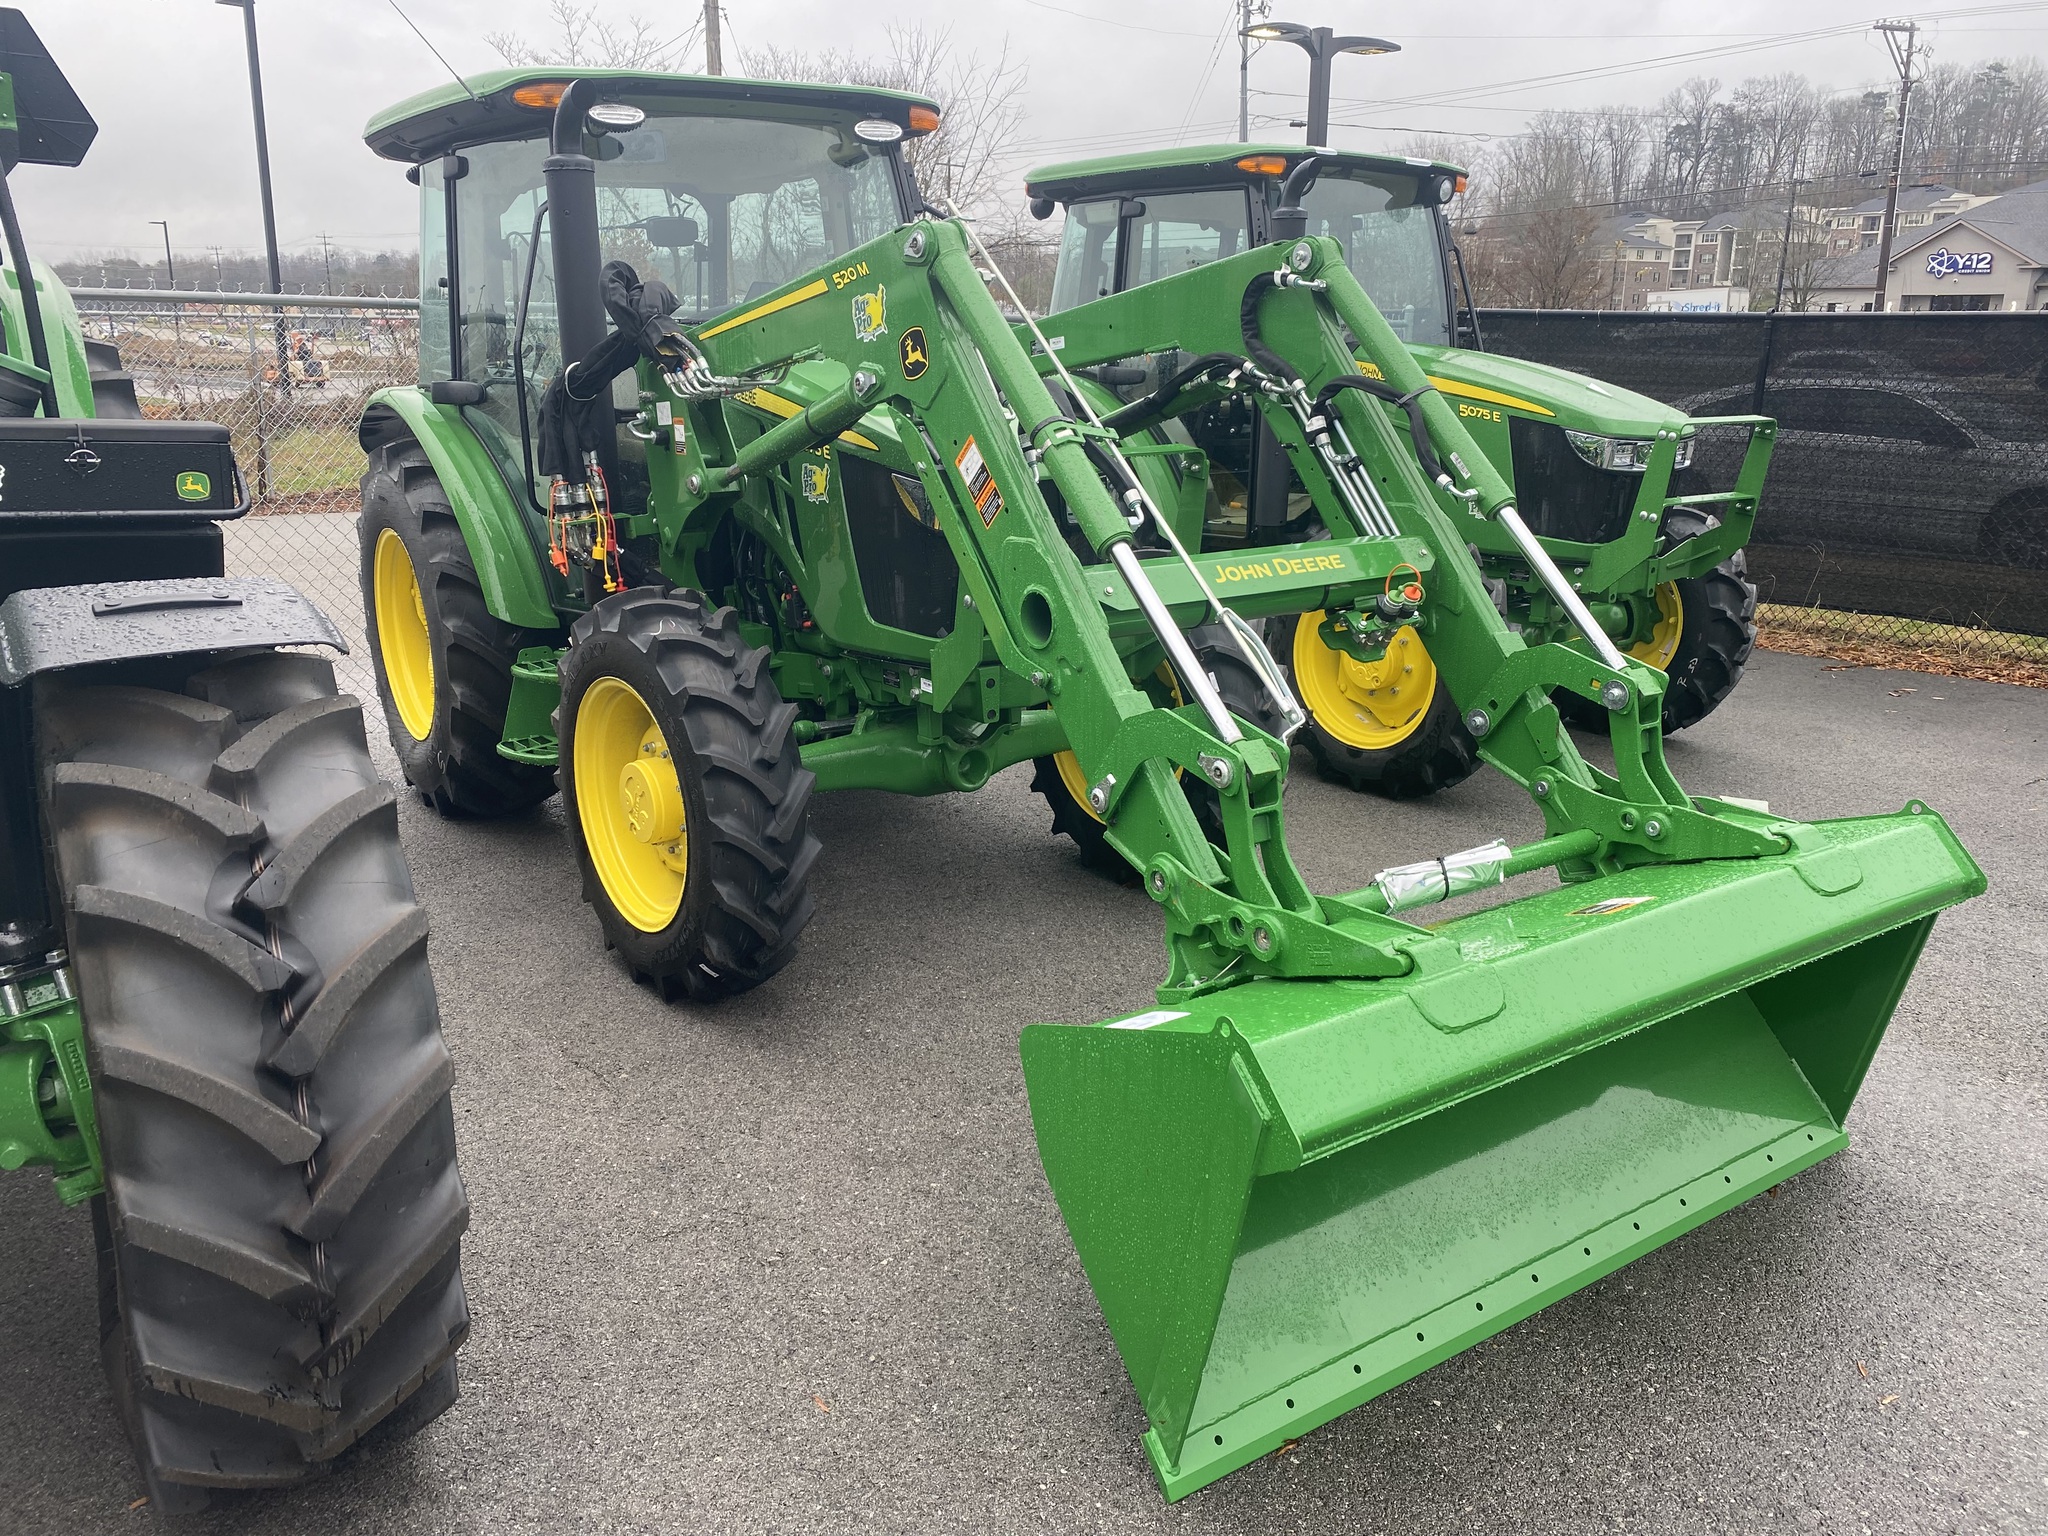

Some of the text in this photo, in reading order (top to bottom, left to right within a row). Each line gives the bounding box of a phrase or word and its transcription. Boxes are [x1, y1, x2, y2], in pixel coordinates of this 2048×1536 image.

[1955, 253, 1992, 269] Y-12
[832, 261, 870, 290] 520 M
[1684, 302, 1721, 312] Shred-it
[856, 315, 872, 334] Pro
[1459, 403, 1501, 422] 5075 E
[803, 481, 817, 494] Pro
[1215, 554, 1346, 583] JOHN DEERE
